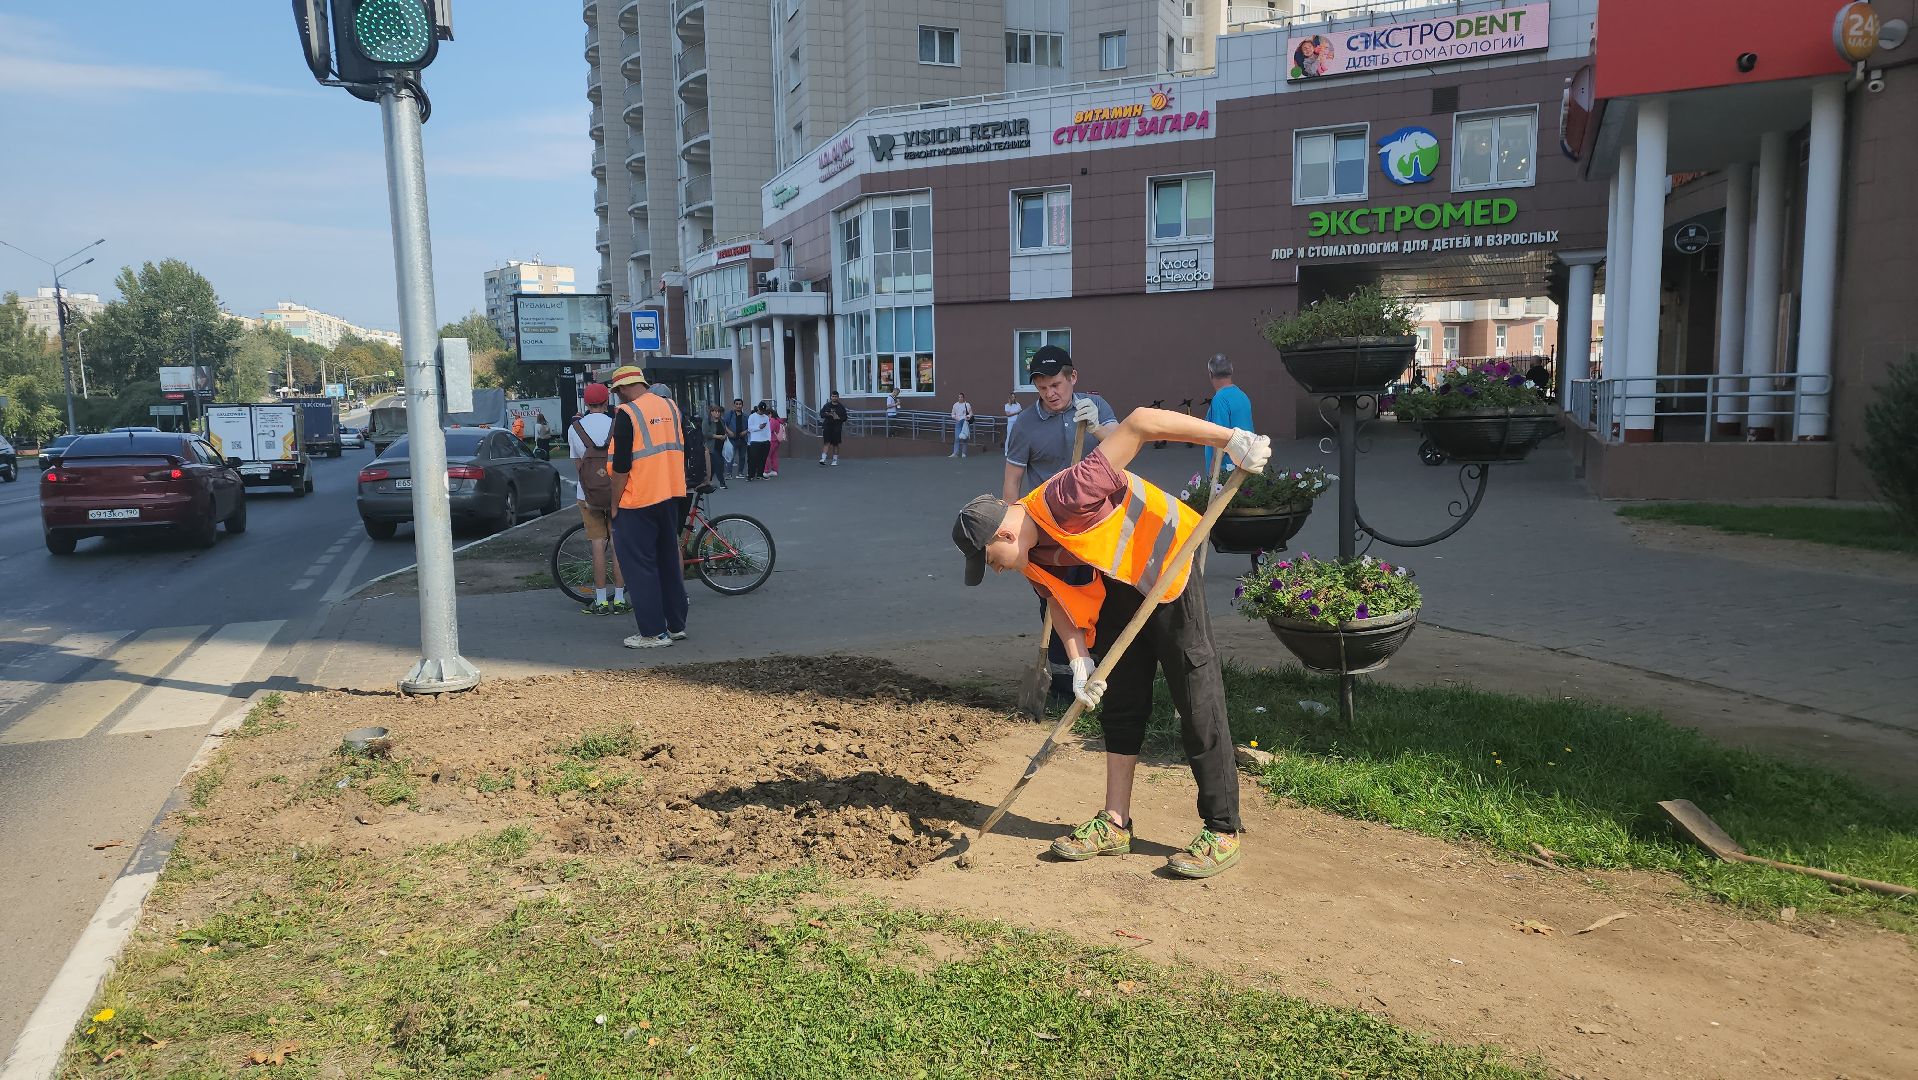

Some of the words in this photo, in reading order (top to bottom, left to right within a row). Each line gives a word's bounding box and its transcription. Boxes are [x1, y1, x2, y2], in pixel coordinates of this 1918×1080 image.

[1849, 13, 1874, 37] 24
[1393, 34, 1525, 63] СТОМАТОЛОГИЙ
[1074, 104, 1144, 124] ВИТАМИН
[903, 126, 961, 148] VISION
[968, 118, 1030, 141] REPAIR
[1053, 119, 1131, 145] СТУДИЯ
[1134, 110, 1210, 137] ЗАГАРА
[903, 149, 937, 160] РЕМОНТ
[937, 141, 992, 157] МОБИЛЬНОЙ
[992, 139, 1031, 151] ТЕХНИКИ
[1271, 247, 1293, 260] ЛОР
[1297, 247, 1305, 259] И
[1307, 241, 1399, 259] СТОМАТОЛОГИЯ
[1402, 239, 1428, 254] ДЛЯ
[1431, 234, 1471, 252] ДЕТЕЙ
[1475, 235, 1483, 246] И
[1486, 230, 1559, 246] ВЗРОСЛЫХ
[1160, 257, 1197, 270] Класс
[1145, 275, 1161, 284] на
[1165, 269, 1211, 282] Чехова
